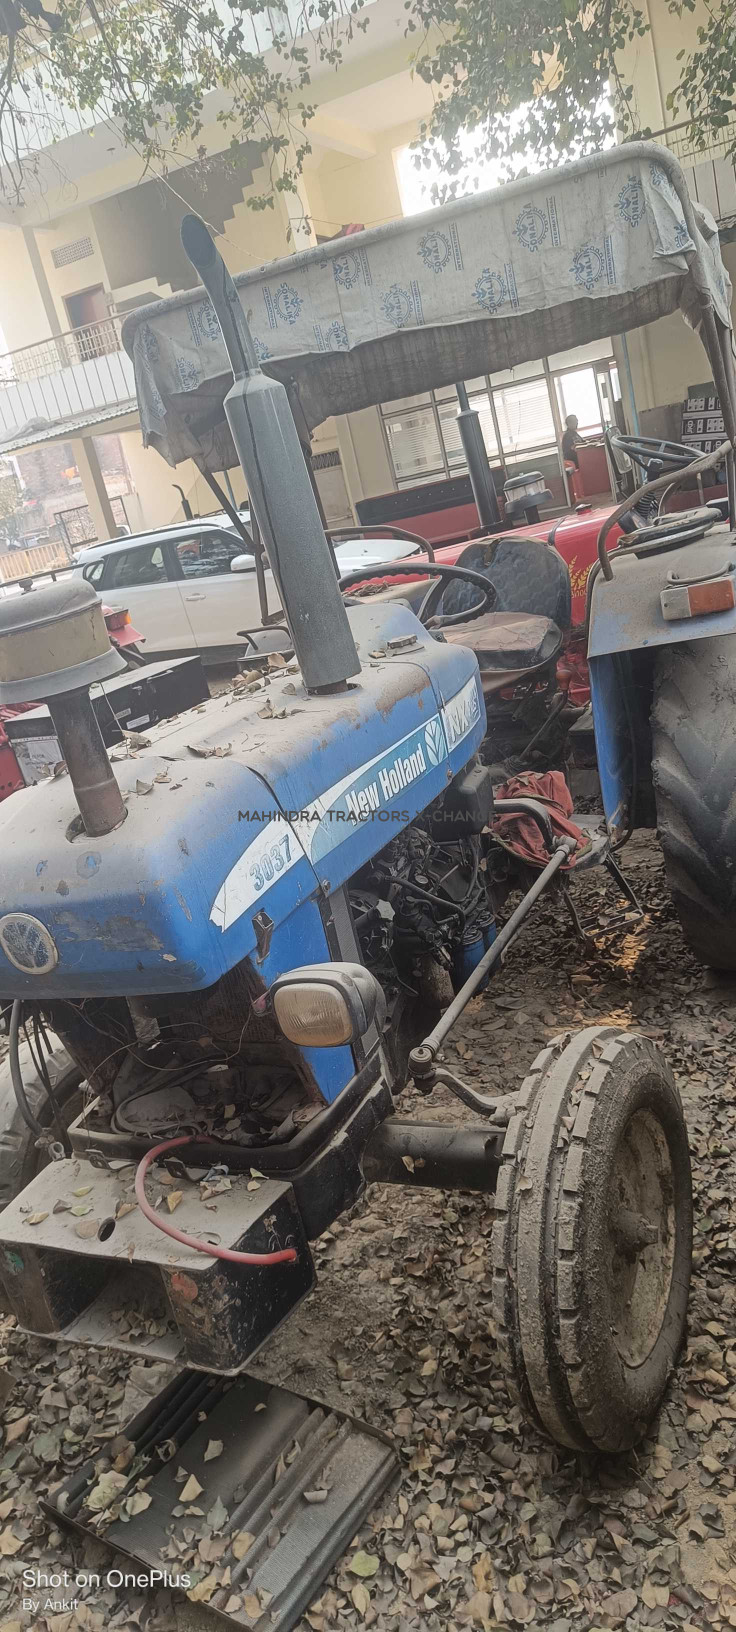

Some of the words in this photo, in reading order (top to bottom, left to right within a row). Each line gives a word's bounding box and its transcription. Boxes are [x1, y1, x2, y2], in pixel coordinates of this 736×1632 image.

[548, 196, 559, 248] INTERNATIONAL
[628, 174, 639, 228] SONALIKA
[523, 202, 538, 253] SONALIKA
[279, 282, 297, 326] SONALIKA
[482, 267, 497, 315] SONALIKA
[344, 781, 382, 828] New
[377, 742, 428, 802] Holland
[249, 833, 292, 892] 3037
